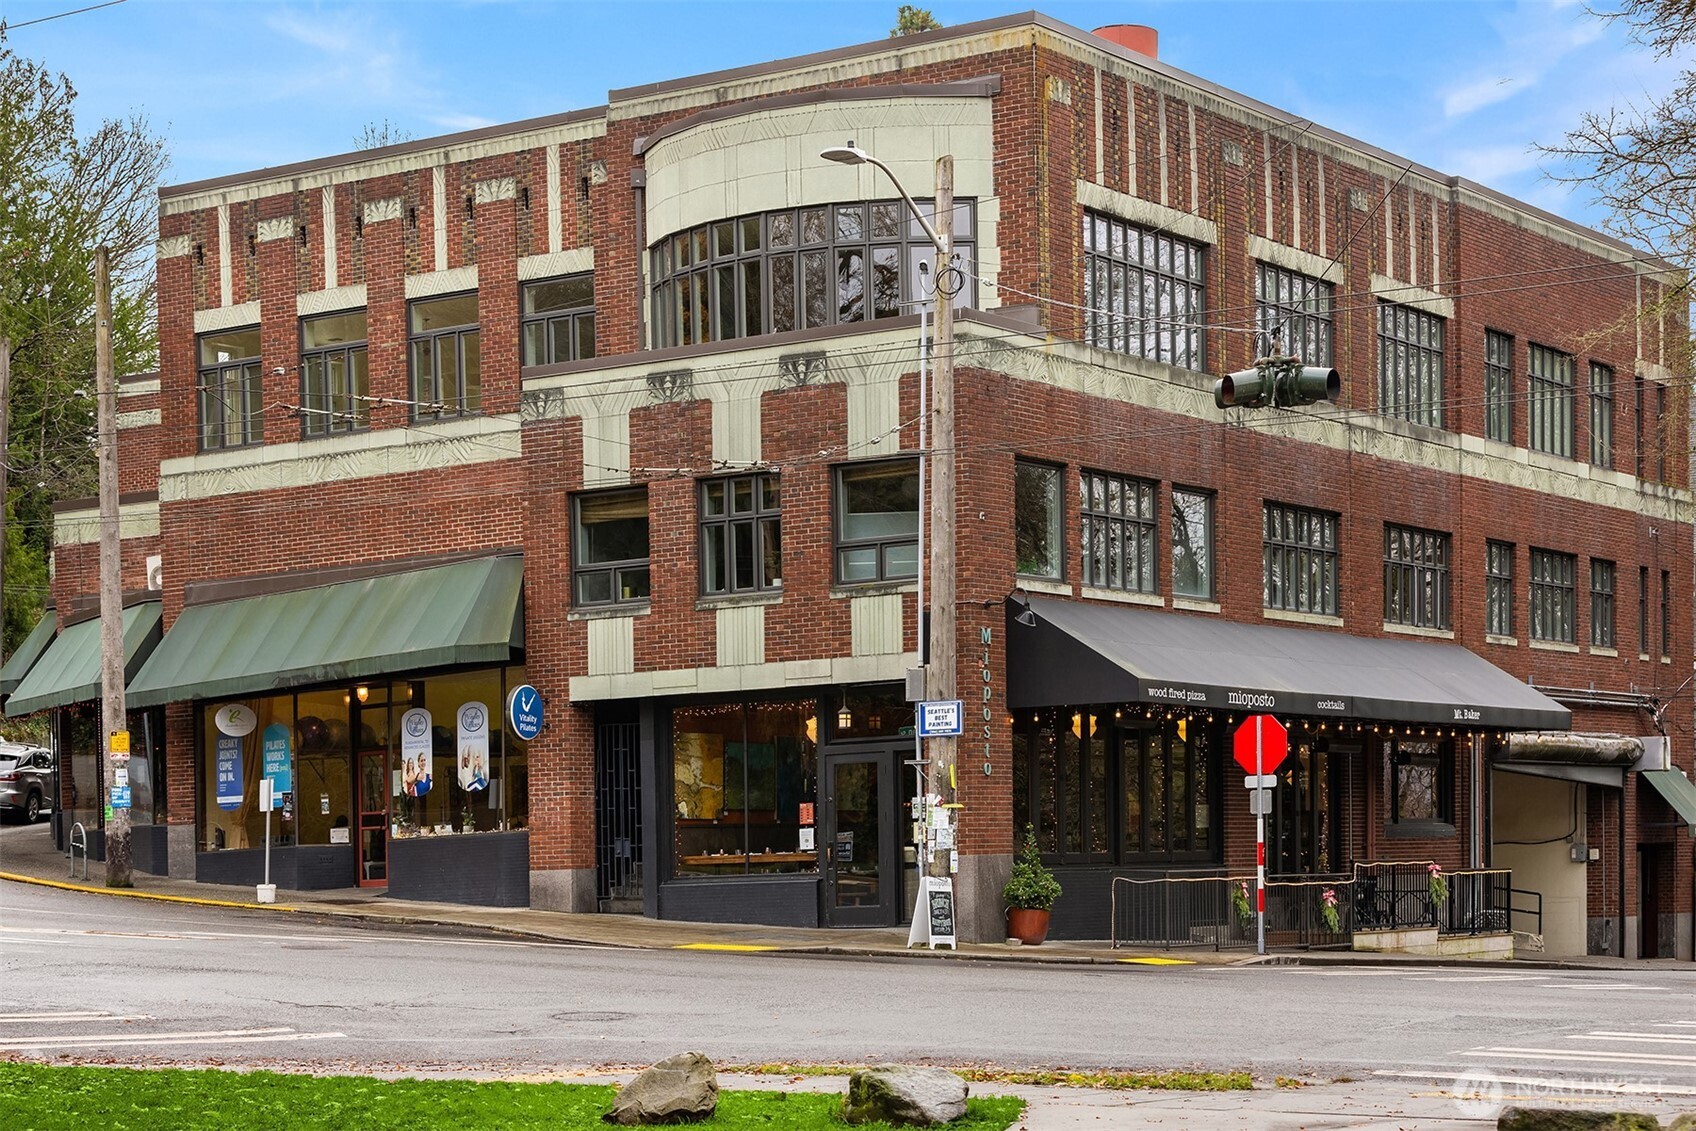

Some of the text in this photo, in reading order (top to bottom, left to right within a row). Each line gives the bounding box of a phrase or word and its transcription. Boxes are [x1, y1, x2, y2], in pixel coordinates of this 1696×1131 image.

[1147, 687, 1206, 702] wood fired pizza
[1228, 690, 1275, 708] mioposto
[980, 626, 992, 776] Mioposto
[1317, 699, 1345, 710] cocktails
[518, 713, 538, 725] Vitality
[1463, 709, 1481, 720] Baker
[519, 722, 537, 732] Pilates
[219, 739, 239, 750] CREAKY
[266, 739, 286, 750] PILATES
[266, 751, 285, 762] WORKS
[219, 761, 233, 771] COME
[266, 762, 280, 773] HERE
[219, 772, 227, 782] ON
